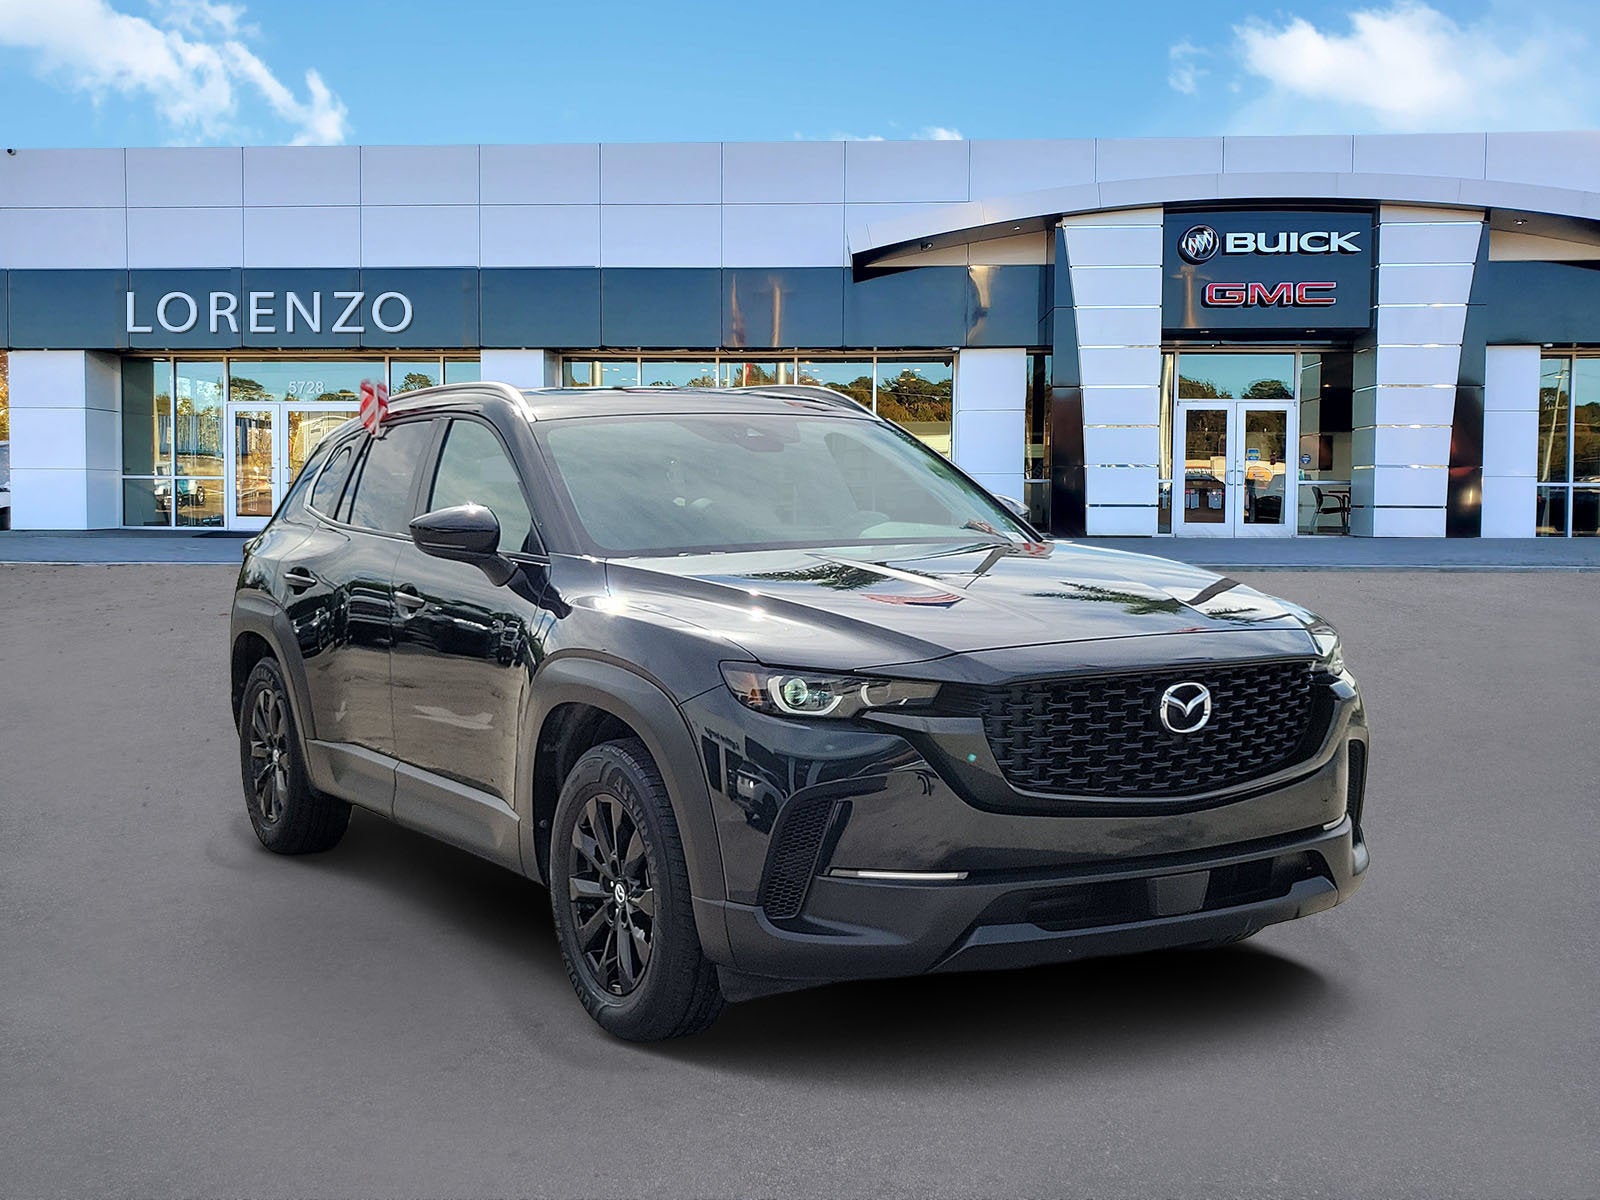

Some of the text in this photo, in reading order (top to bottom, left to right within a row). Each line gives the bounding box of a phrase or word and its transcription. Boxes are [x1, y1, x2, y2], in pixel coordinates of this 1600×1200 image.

[1225, 231, 1361, 253] BUICK
[1204, 282, 1337, 305] GMC
[126, 291, 413, 333] LORENZO
[288, 381, 325, 394] 5728
